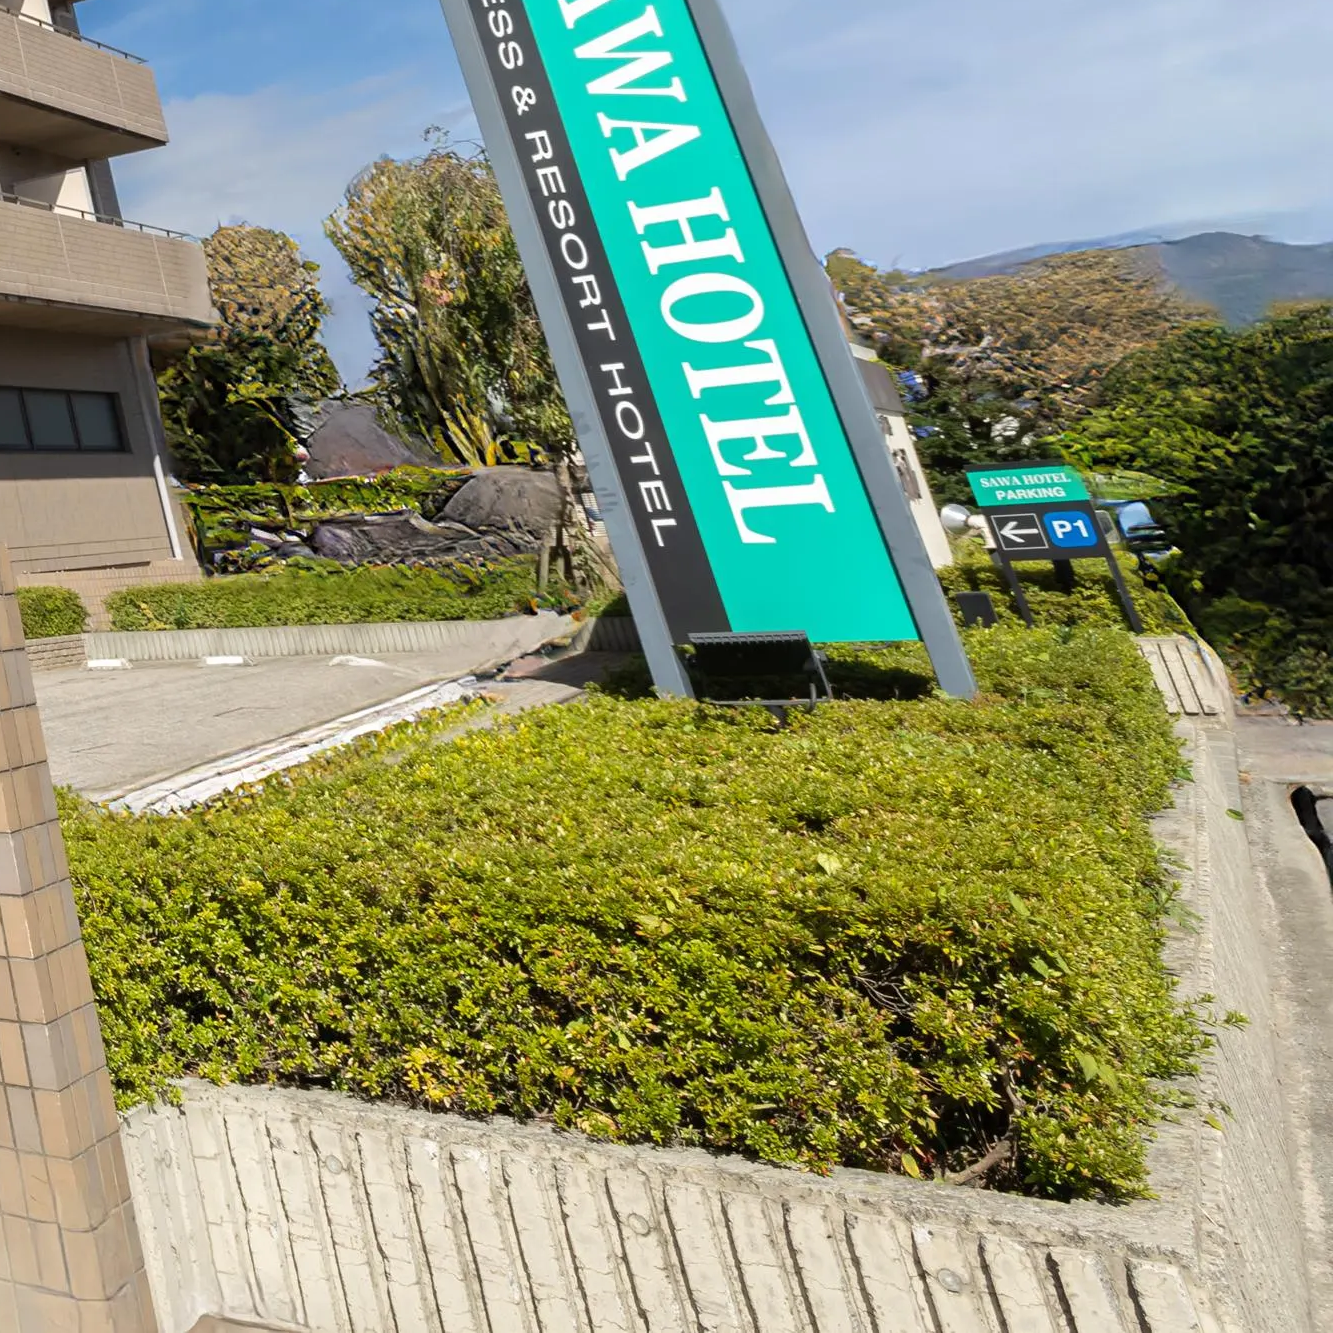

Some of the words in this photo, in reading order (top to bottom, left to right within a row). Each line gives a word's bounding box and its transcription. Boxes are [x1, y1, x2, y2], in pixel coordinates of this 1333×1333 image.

[511, 85, 537, 116] &
[524, 129, 616, 341] RESORT
[600, 362, 677, 547] HOTEL
[627, 186, 835, 544] HOTEL
[979, 476, 1021, 488] SAWA
[1022, 472, 1071, 484] HOTEL
[995, 486, 1066, 500] PARKING
[1051, 519, 1089, 539] P1
